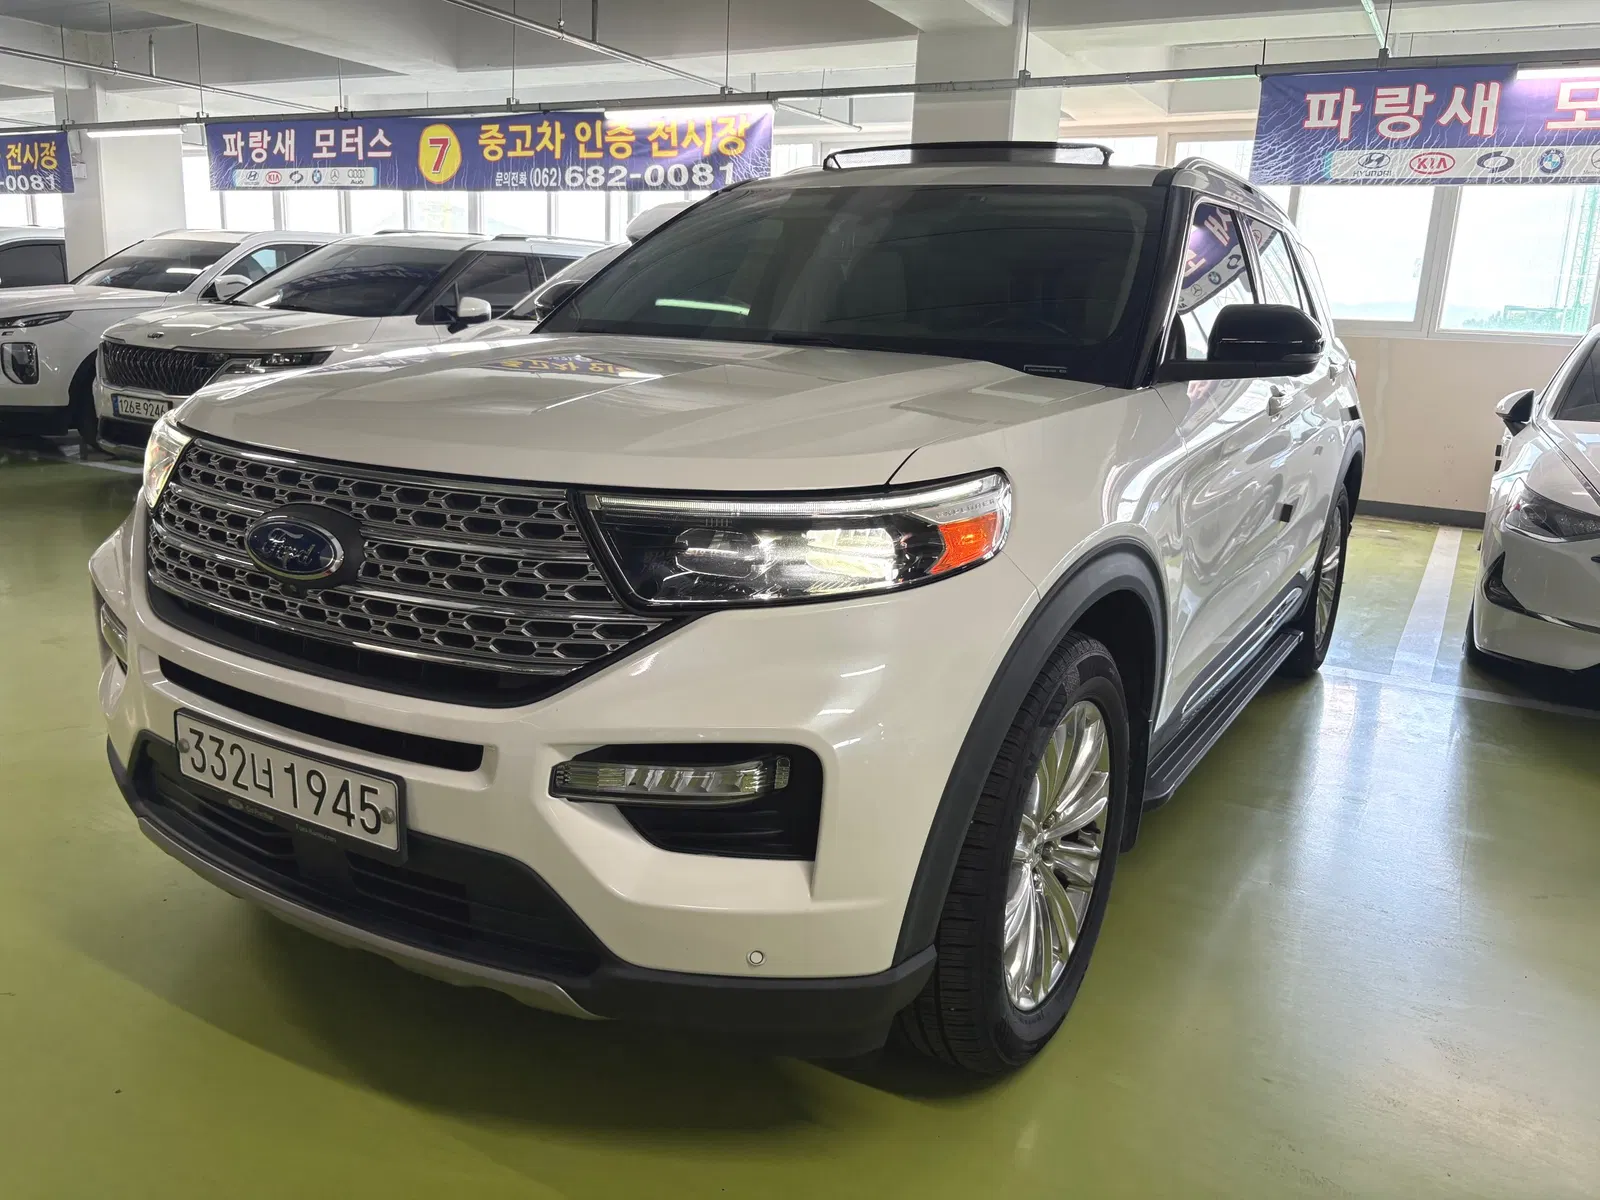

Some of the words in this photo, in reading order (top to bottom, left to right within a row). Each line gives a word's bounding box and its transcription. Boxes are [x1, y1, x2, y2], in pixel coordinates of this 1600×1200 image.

[1302, 81, 1502, 141] 파랑새
[5, 140, 58, 170] 전시장
[222, 128, 296, 164] 파랑새
[312, 125, 393, 160] 모터스
[427, 137, 451, 175] 7
[478, 119, 566, 160] 중고차
[574, 119, 636, 159] 인증
[647, 113, 751, 157] 전시장
[495, 170, 527, 187] 문의전화
[529, 166, 562, 188] (062)
[564, 162, 735, 188] 682-0081
[261, 527, 316, 569] Ford
[188, 727, 276, 799] 332너
[283, 762, 382, 836] 1945
